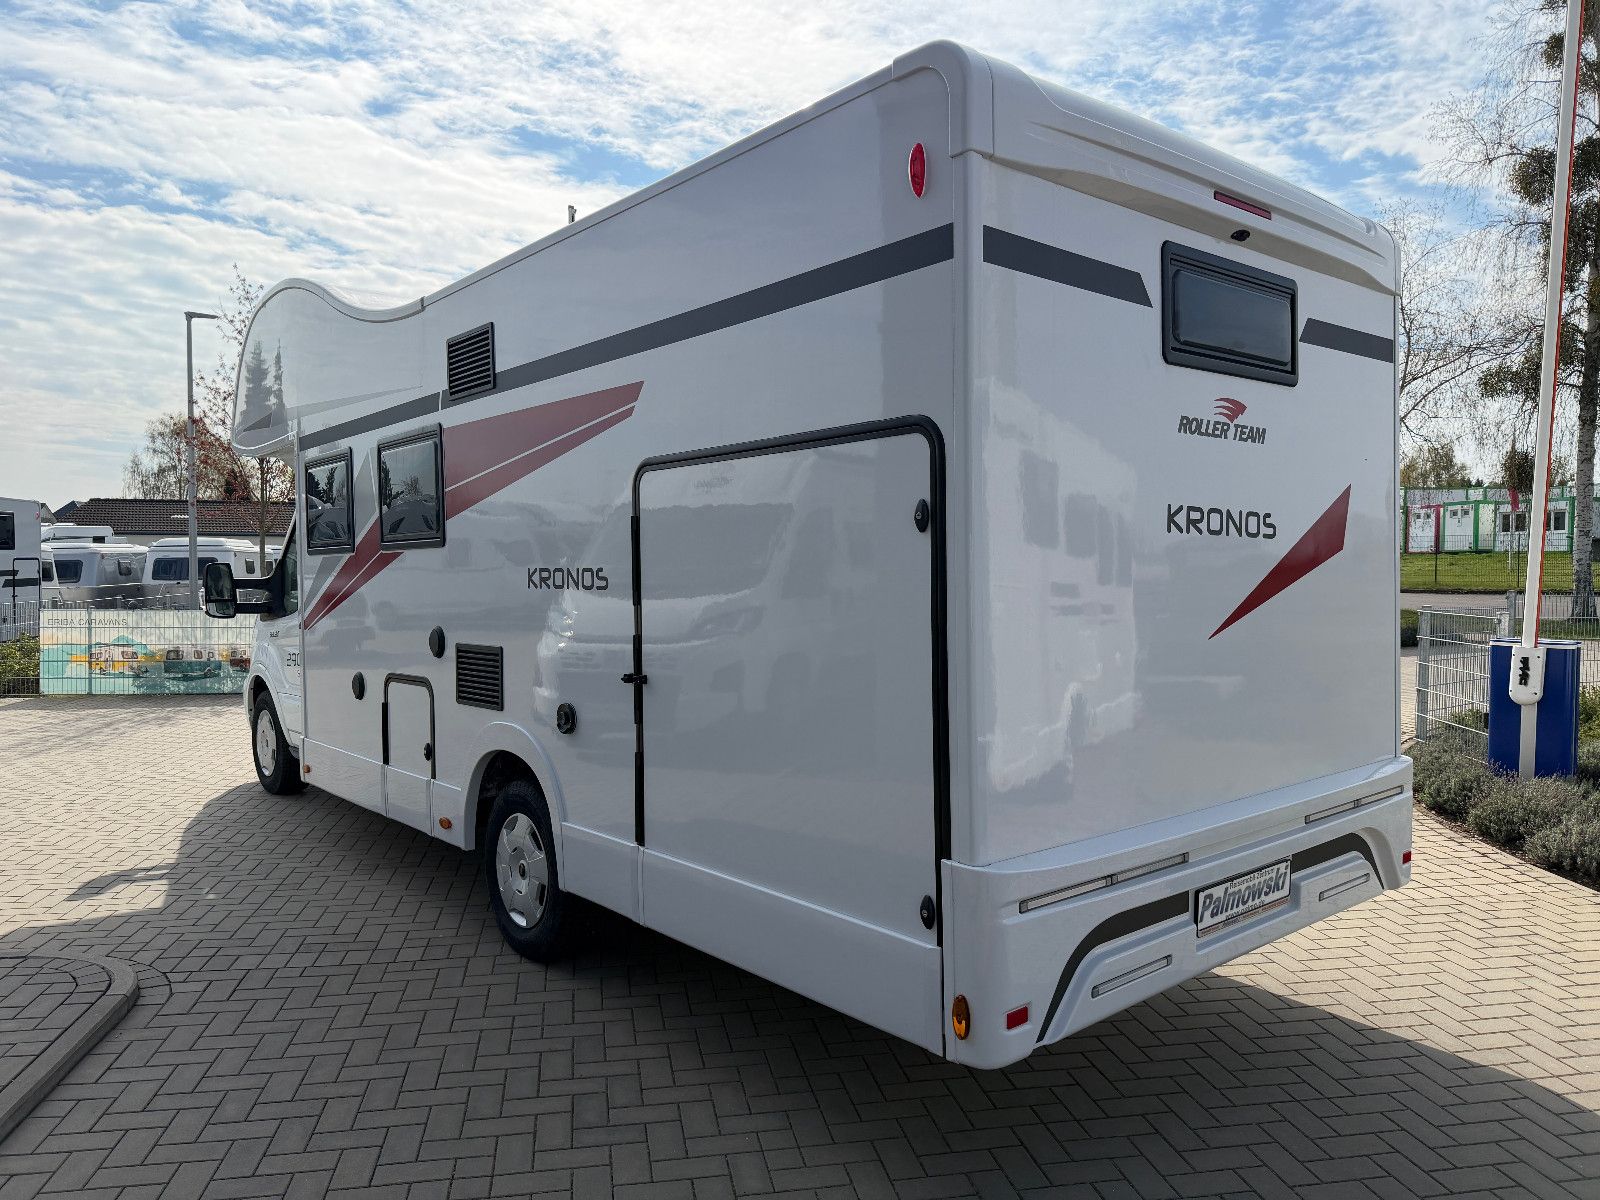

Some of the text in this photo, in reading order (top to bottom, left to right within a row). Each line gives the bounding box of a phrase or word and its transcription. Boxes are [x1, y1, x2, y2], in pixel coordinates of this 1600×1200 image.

[1177, 414, 1267, 445] ROLLER TEAM
[1166, 503, 1277, 540] KRONOS
[527, 566, 609, 591] KRONOS
[47, 618, 128, 626] ERIBA CARAVANS
[1199, 863, 1290, 924] Palmowski
